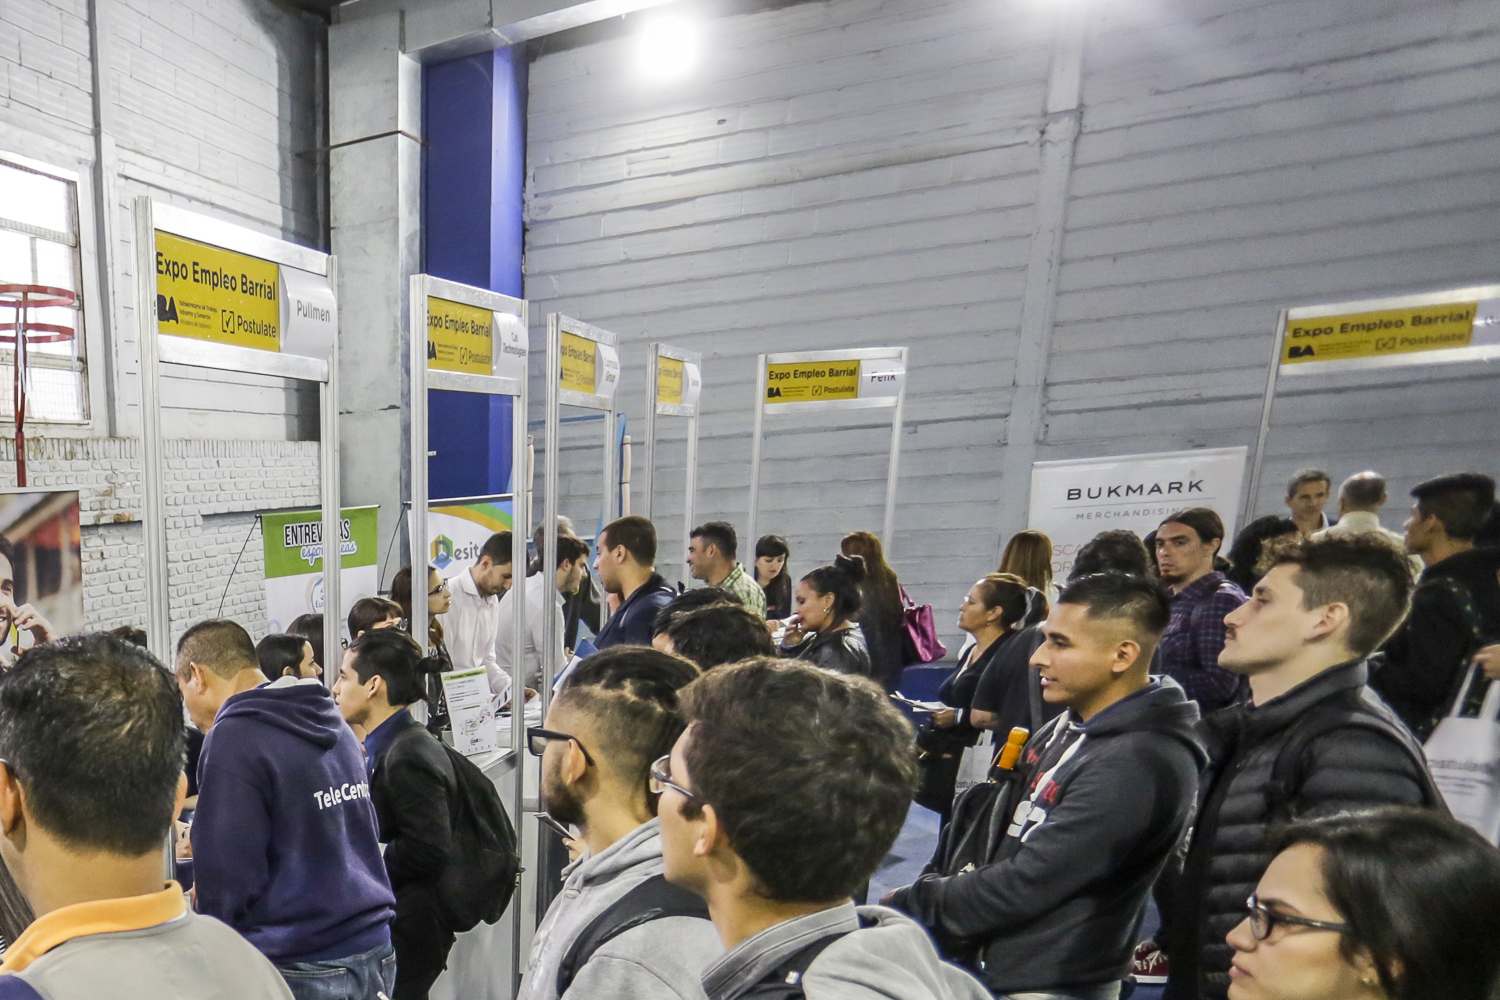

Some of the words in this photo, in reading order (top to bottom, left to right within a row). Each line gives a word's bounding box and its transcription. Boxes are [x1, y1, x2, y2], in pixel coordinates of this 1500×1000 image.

[156, 251, 188, 283] Expo
[192, 261, 237, 292] Empleo
[240, 273, 276, 301] Barrial
[296, 300, 331, 323] Pullmen
[237, 315, 277, 338] Postulate
[444, 314, 470, 335] Empleo
[470, 319, 491, 338] Barrial
[1291, 326, 1334, 339] Expo
[1339, 317, 1405, 334] Empleo
[1410, 309, 1470, 327] Barrial
[769, 370, 791, 381] Expo
[793, 368, 826, 380] Empleo
[828, 366, 857, 378] Barrial
[1066, 479, 1205, 501] BUKMARK
